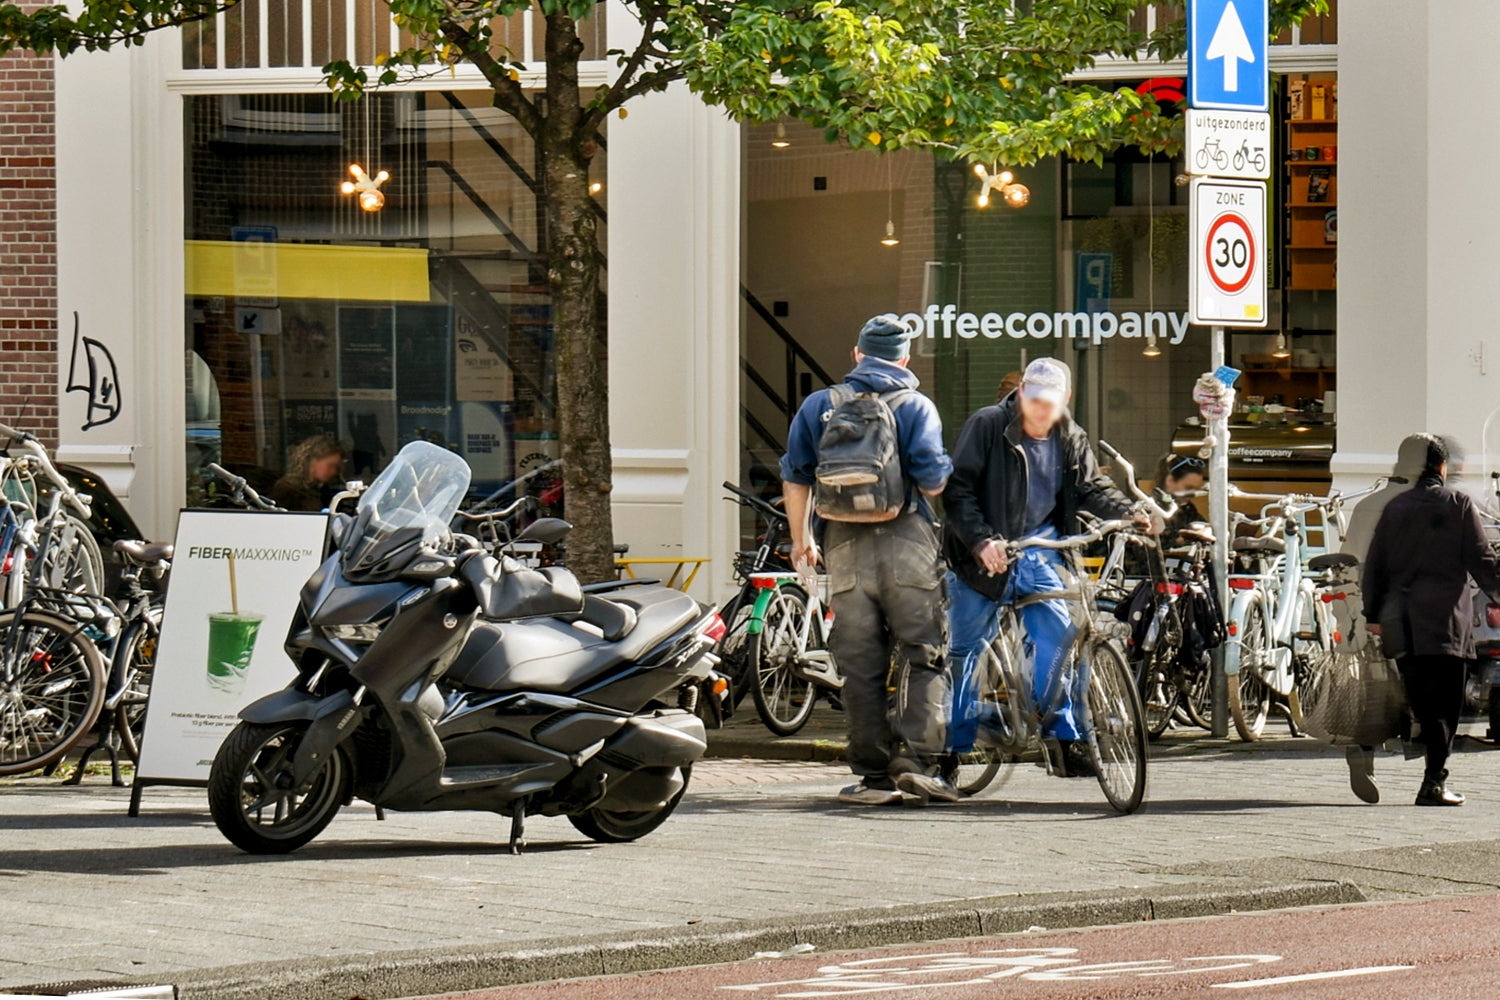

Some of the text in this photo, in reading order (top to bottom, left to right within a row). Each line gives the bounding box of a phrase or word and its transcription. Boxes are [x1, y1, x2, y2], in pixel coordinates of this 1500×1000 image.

[1196, 116, 1266, 132] uitgezonderd
[1216, 192, 1245, 205] ZONE
[1215, 238, 1247, 268] 30
